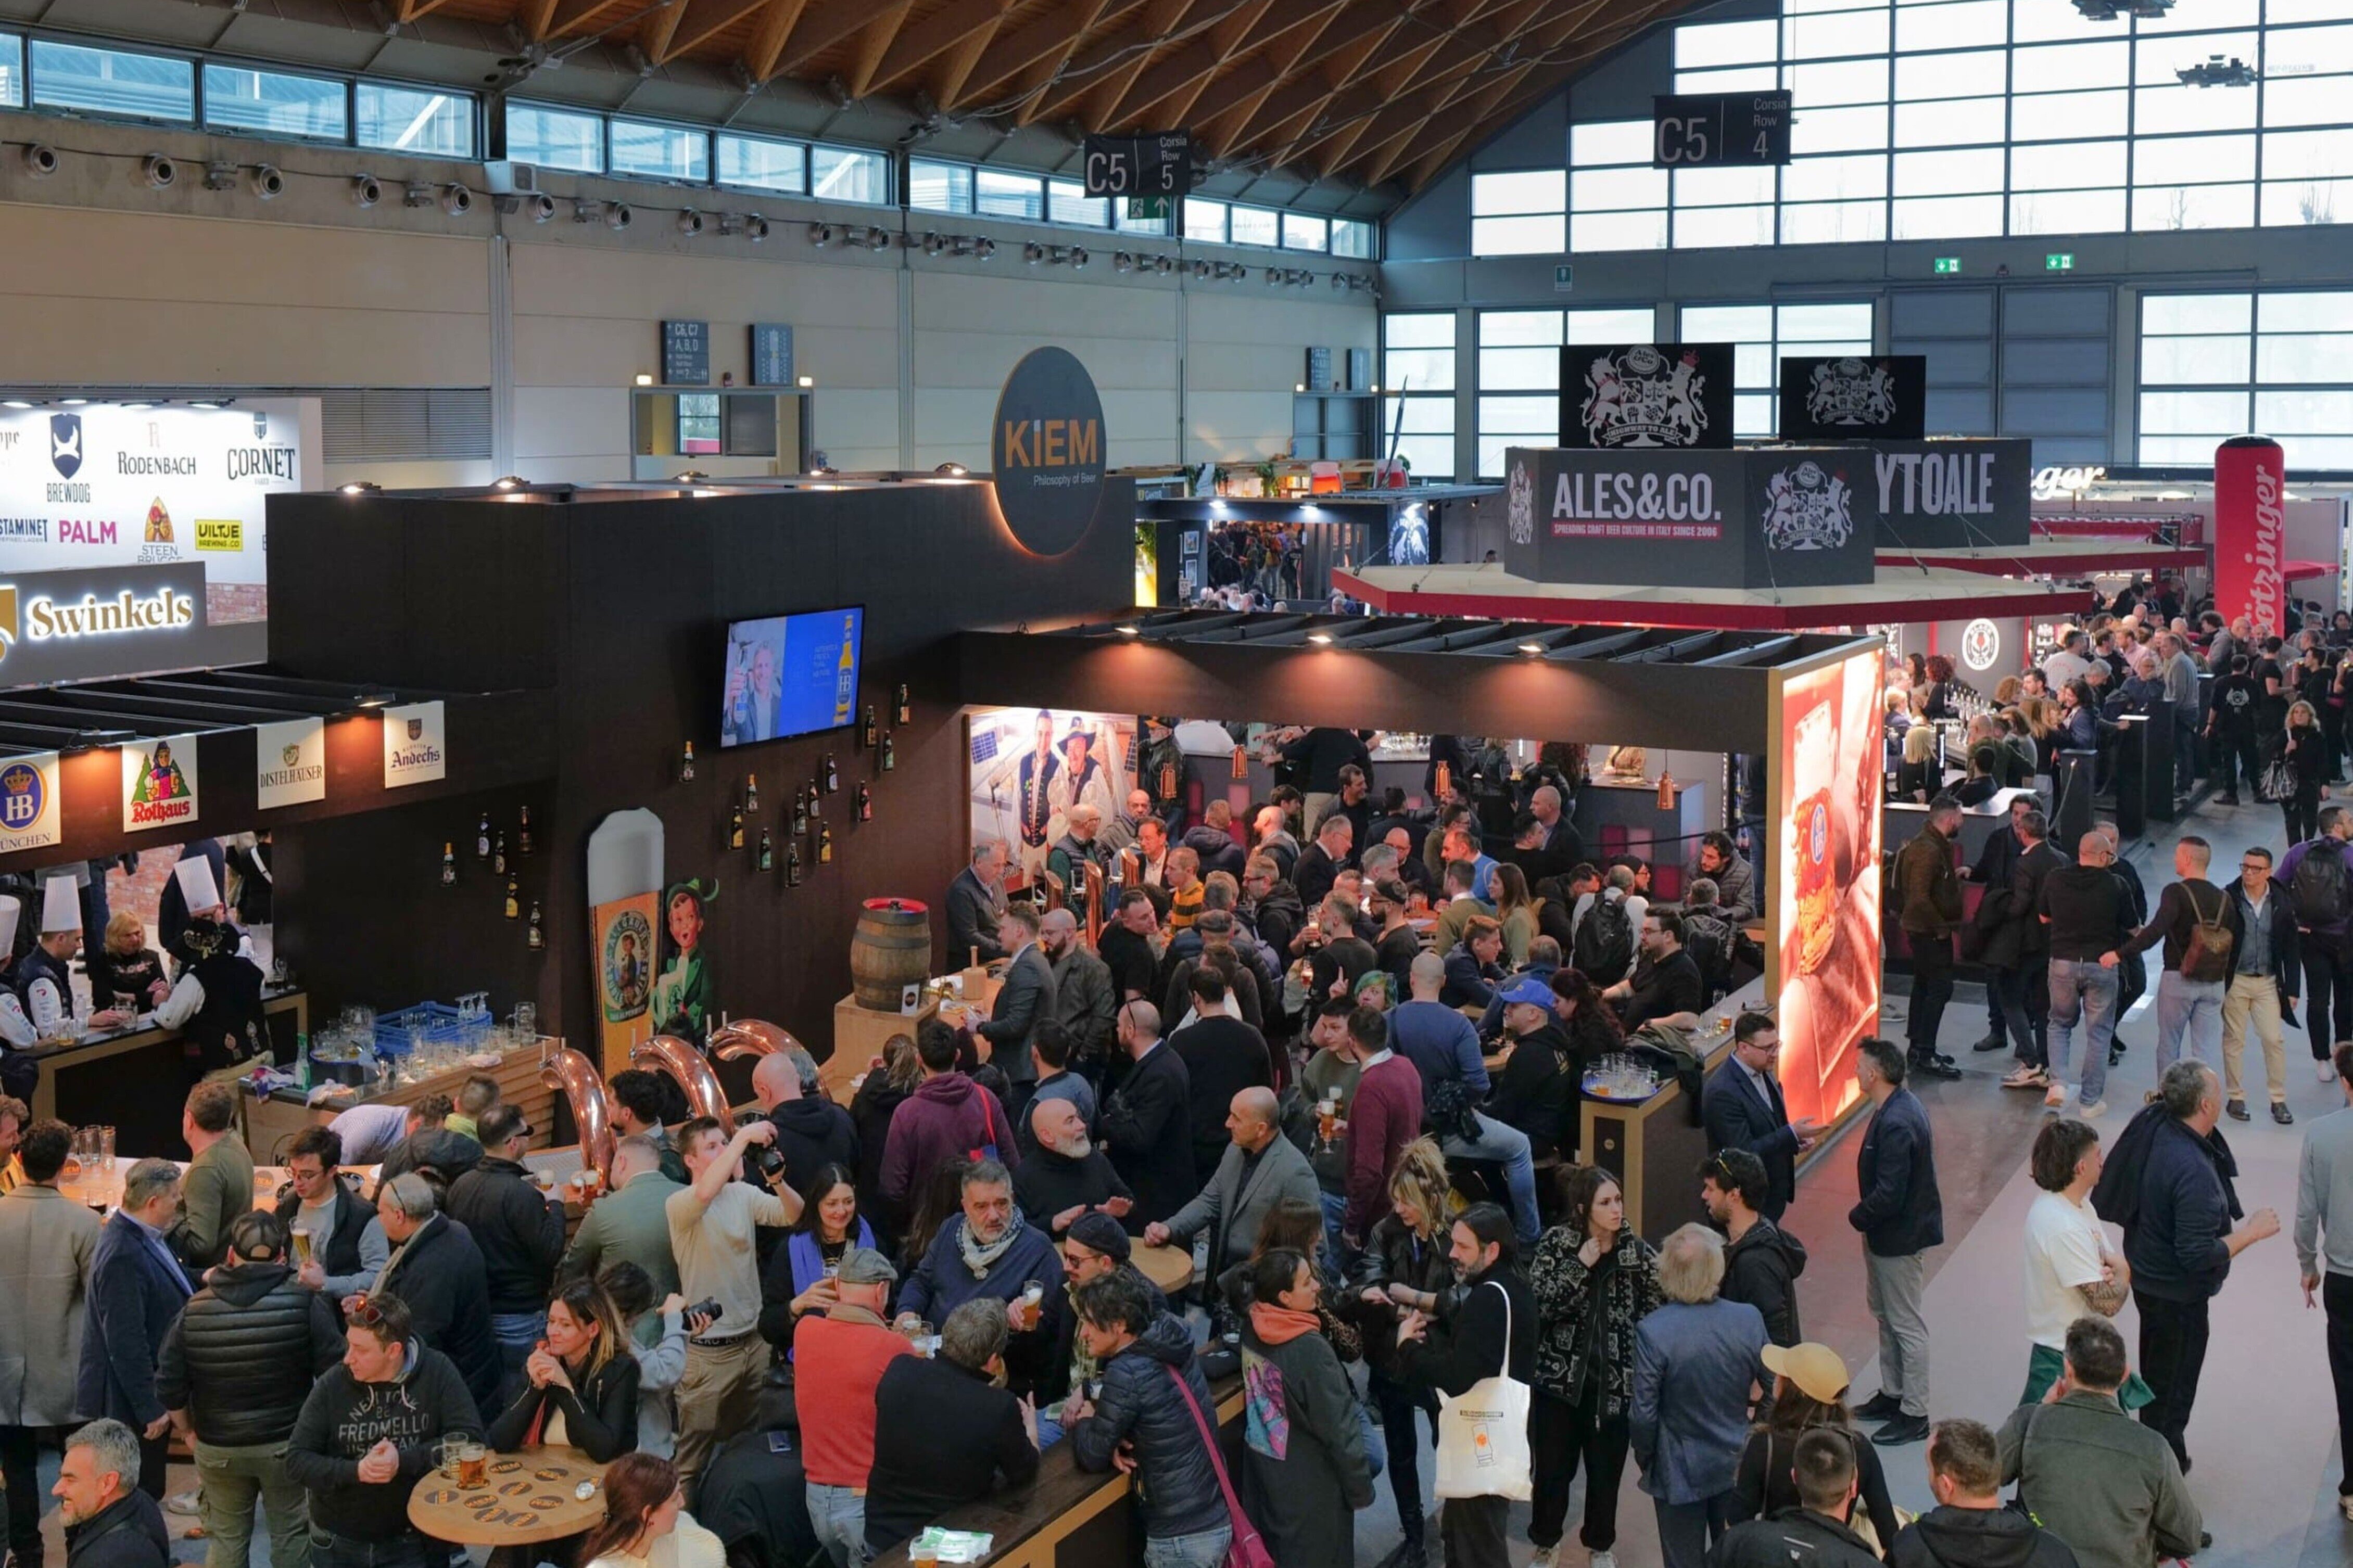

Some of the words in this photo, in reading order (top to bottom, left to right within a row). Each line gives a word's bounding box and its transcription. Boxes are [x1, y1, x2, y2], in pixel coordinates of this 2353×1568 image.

[1753, 97, 1787, 111] Corsia
[1753, 114, 1778, 127] Row
[1159, 136, 1187, 148] Corsia
[1657, 117, 1708, 163] C5
[1752, 130, 1769, 159] 4
[1161, 150, 1181, 161] Row
[1086, 152, 1127, 193] C5
[1161, 164, 1173, 190] 5
[1610, 424, 1647, 436] HIGHWAY
[1660, 427, 1676, 435] ALE
[227, 448, 295, 480] CORNET
[1034, 475, 1070, 487] Philosophy
[1072, 474, 1079, 484] of
[1081, 473, 1096, 483] Beer
[2031, 467, 2105, 500] ger
[47, 483, 90, 503] BREWDOG
[1553, 473, 1721, 520] ALES&CO.
[59, 520, 117, 544] PALM
[198, 524, 239, 538] UILTJE
[1554, 524, 1586, 534] SPREADING
[1587, 525, 1605, 534] CRAFT
[1606, 525, 1621, 535] BEER
[1622, 525, 1647, 536] CULTURE
[1648, 526, 1654, 535] IN
[1655, 526, 1671, 536] ITALY
[1673, 526, 1695, 536] SINCE
[142, 545, 178, 555] STEEN
[2245, 464, 2282, 636] ötzinger
[31, 588, 194, 638] Swinkels
[390, 746, 440, 768] Andechs
[6, 795, 34, 821] HB
[132, 801, 190, 823] Rothaus
[0, 834, 50, 850] ÜNCHEN
[339, 1413, 429, 1442] FREDMELLO
